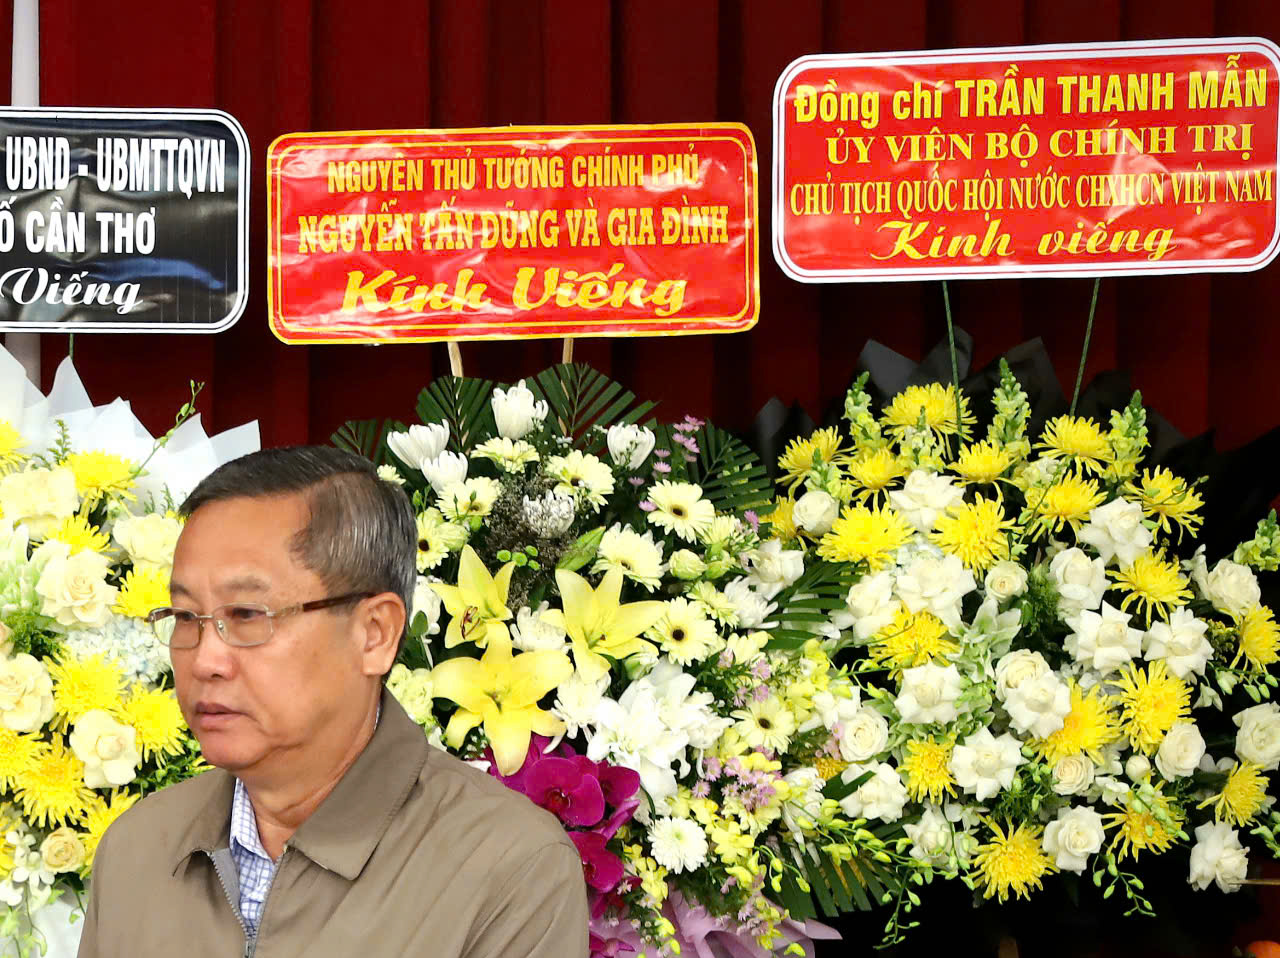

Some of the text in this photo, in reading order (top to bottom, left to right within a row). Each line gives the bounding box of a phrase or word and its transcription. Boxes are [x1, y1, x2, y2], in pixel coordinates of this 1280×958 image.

[794, 54, 1268, 130] Đồng chí TRẦN THANH MẪN
[6, 136, 70, 191] UBND
[97, 138, 226, 199] UBMTTQVN
[327, 143, 699, 193] NGUYÊN THỦ TƯỚNG CHÍNH PHỦ
[826, 120, 1254, 168] ỦY VIÊN BỘ CHÍNH TRỊ
[790, 162, 1273, 223] CHỦ TỊCH QUỐC HỘI NƯỚC CHXHCN VIỆT NAM
[26, 197, 85, 253] CẦN
[96, 207, 156, 254] THƠ
[298, 195, 729, 254] NGUYỄN TẤN DŨNG VÀ GIA ĐÌNH
[871, 219, 1177, 261] Kính viếng
[340, 263, 688, 316] Kính Viếng
